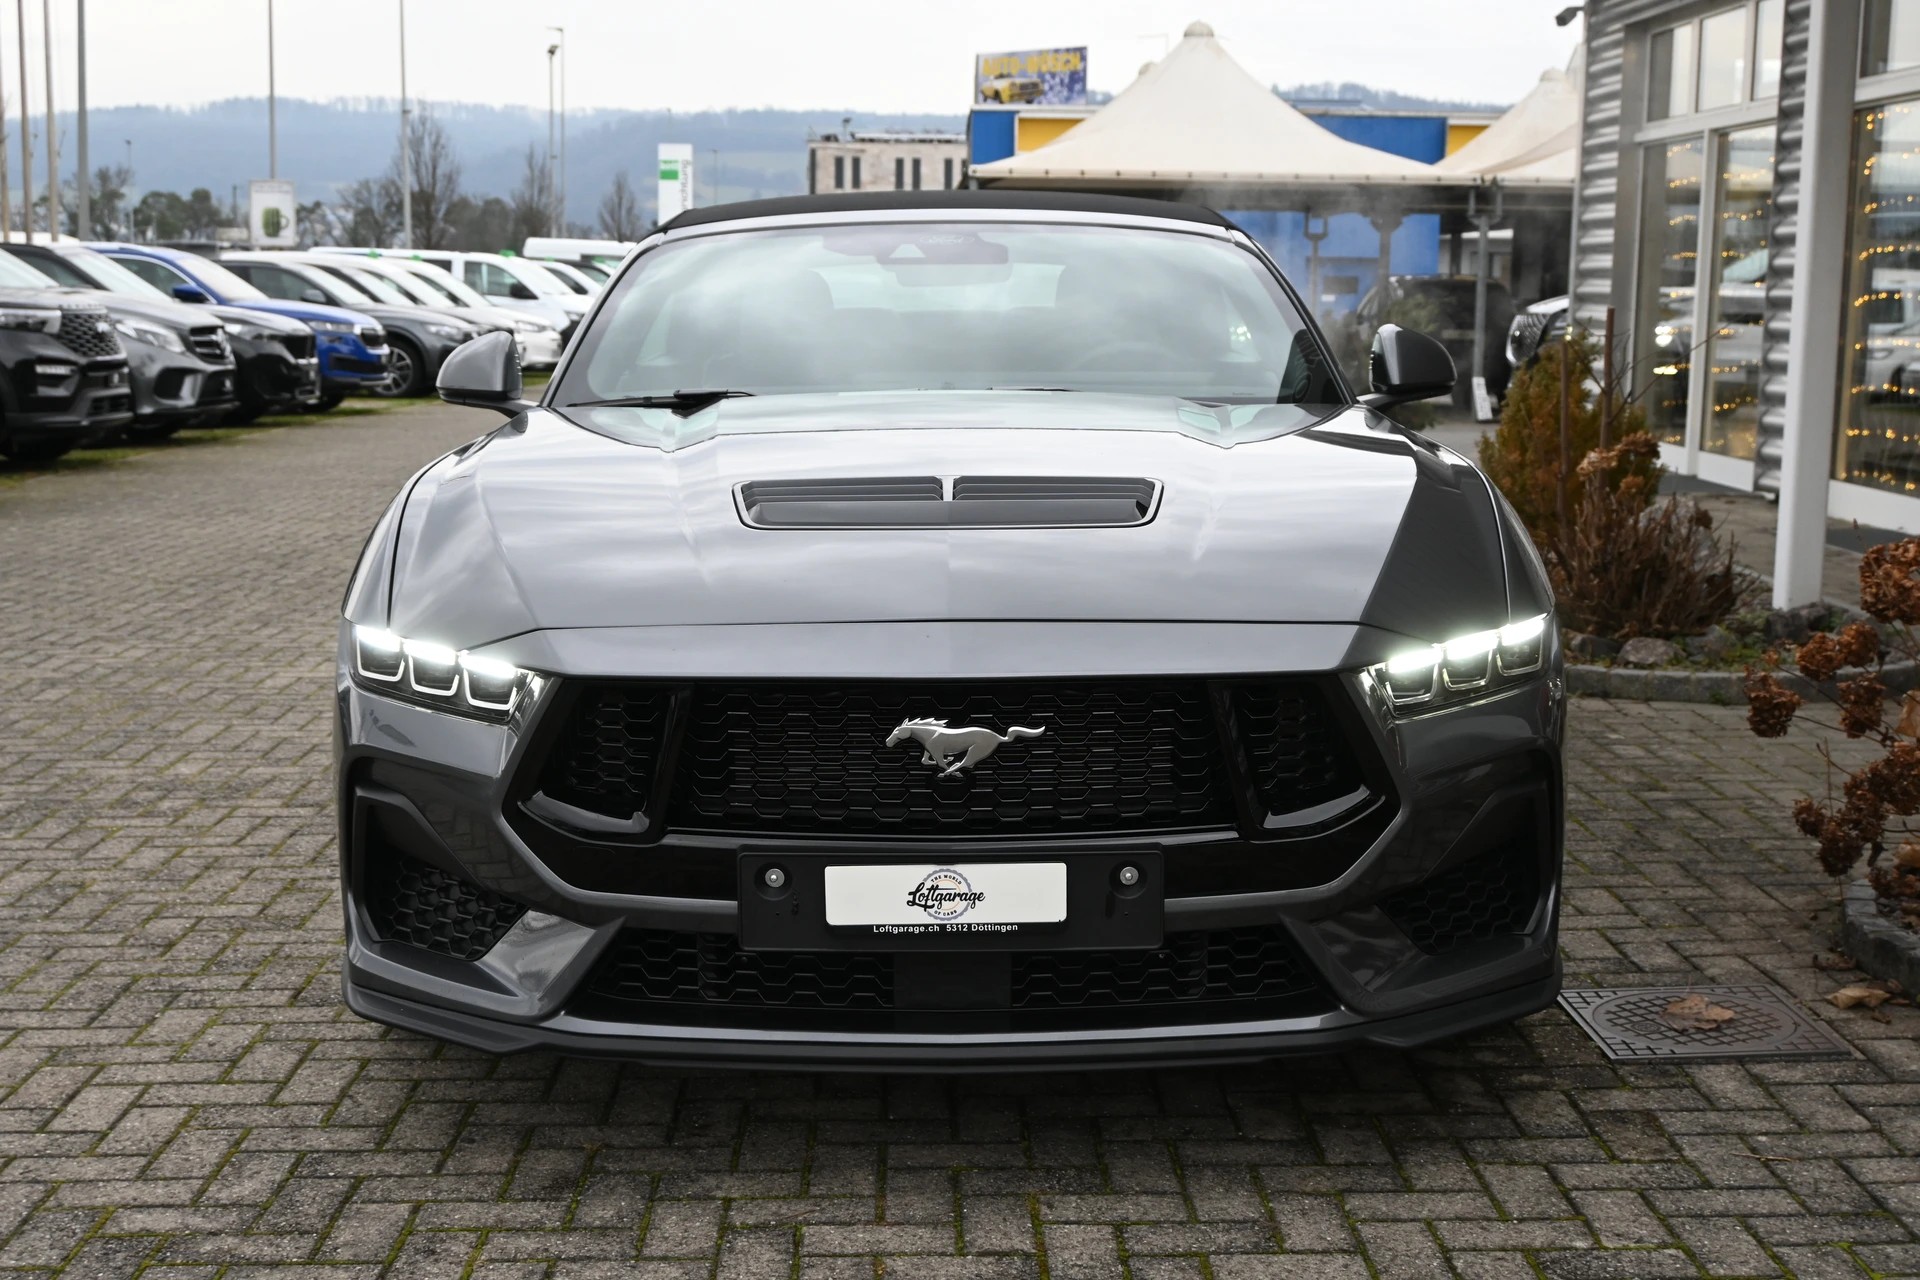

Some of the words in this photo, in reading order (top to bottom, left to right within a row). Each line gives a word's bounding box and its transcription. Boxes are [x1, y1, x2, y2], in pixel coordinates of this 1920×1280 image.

[931, 875, 942, 883] THE
[943, 874, 962, 885] WORLD
[907, 882, 985, 912] Loftgarage
[873, 924, 940, 934] Loftgarage.ch
[946, 923, 968, 932] 5312
[971, 923, 1018, 933] Döttingen
